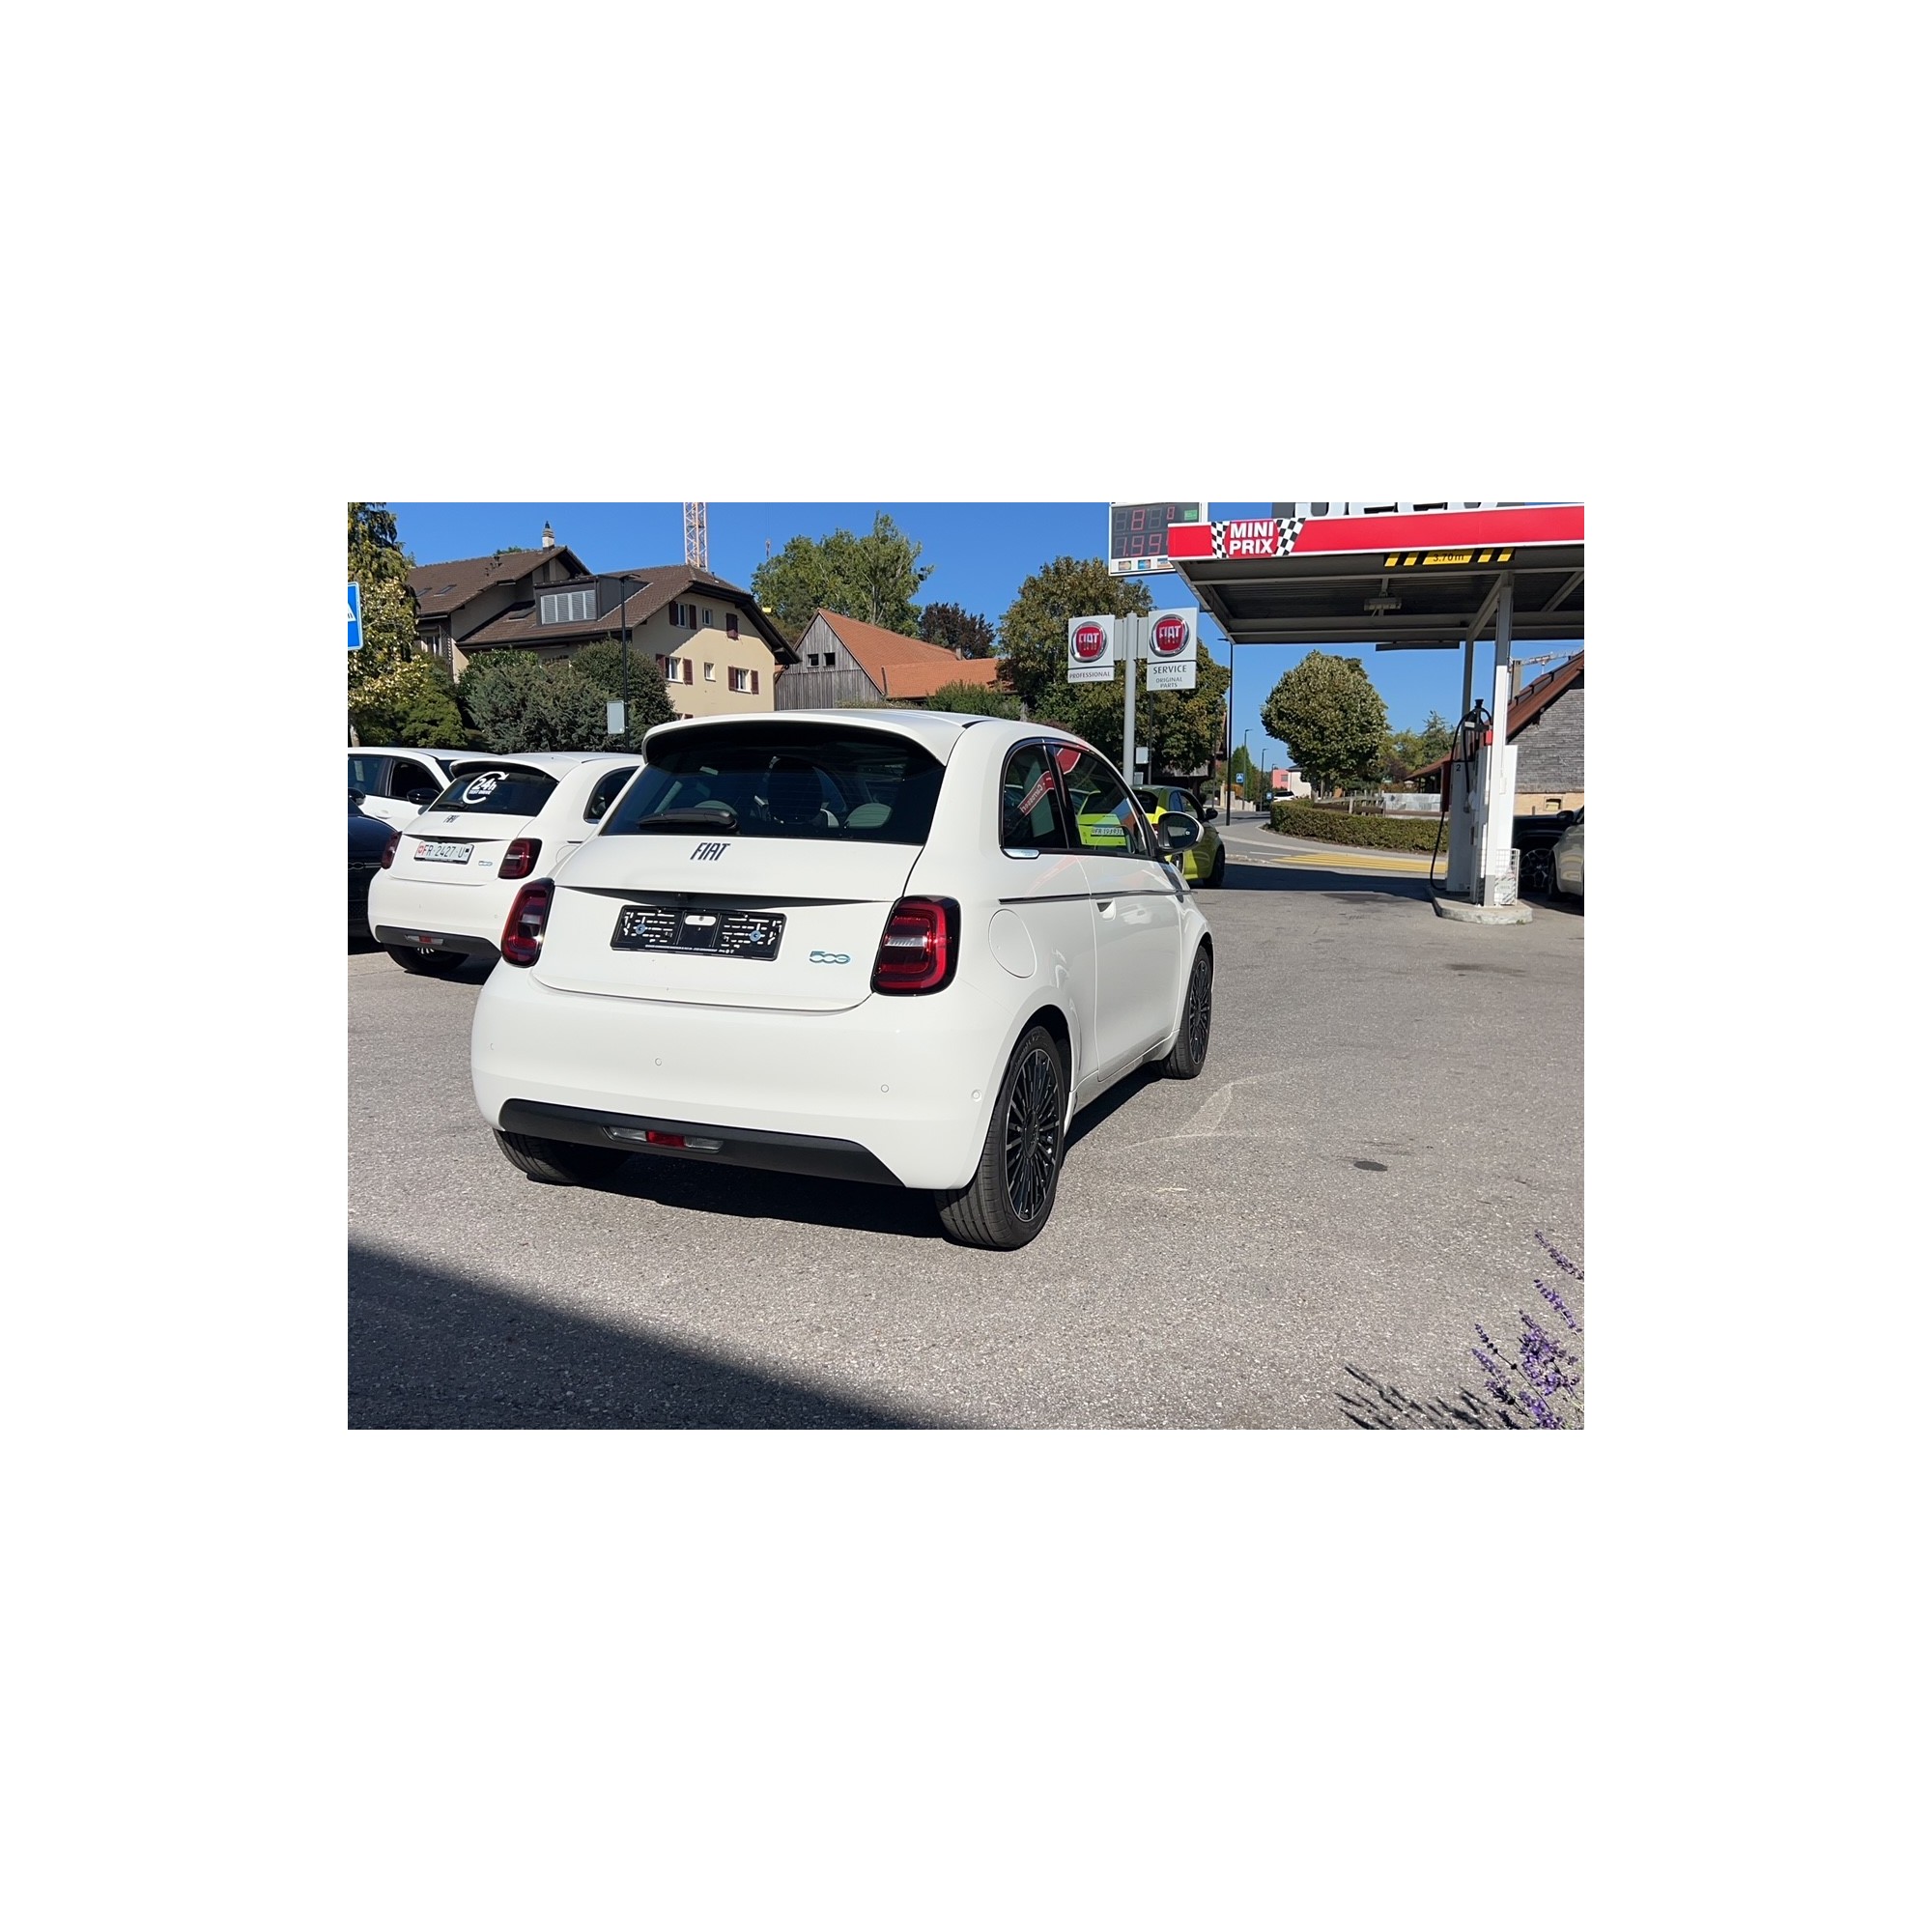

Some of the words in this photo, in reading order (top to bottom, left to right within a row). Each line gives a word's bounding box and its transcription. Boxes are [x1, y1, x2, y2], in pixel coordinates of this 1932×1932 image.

[1230, 522, 1274, 539] MINI
[1229, 538, 1273, 555] PRIX
[1078, 633, 1100, 650] FIAT
[1158, 625, 1181, 643] FIAT
[1153, 665, 1187, 674] SERVICE
[471, 778, 497, 791] 24h
[690, 842, 730, 861] FIAT
